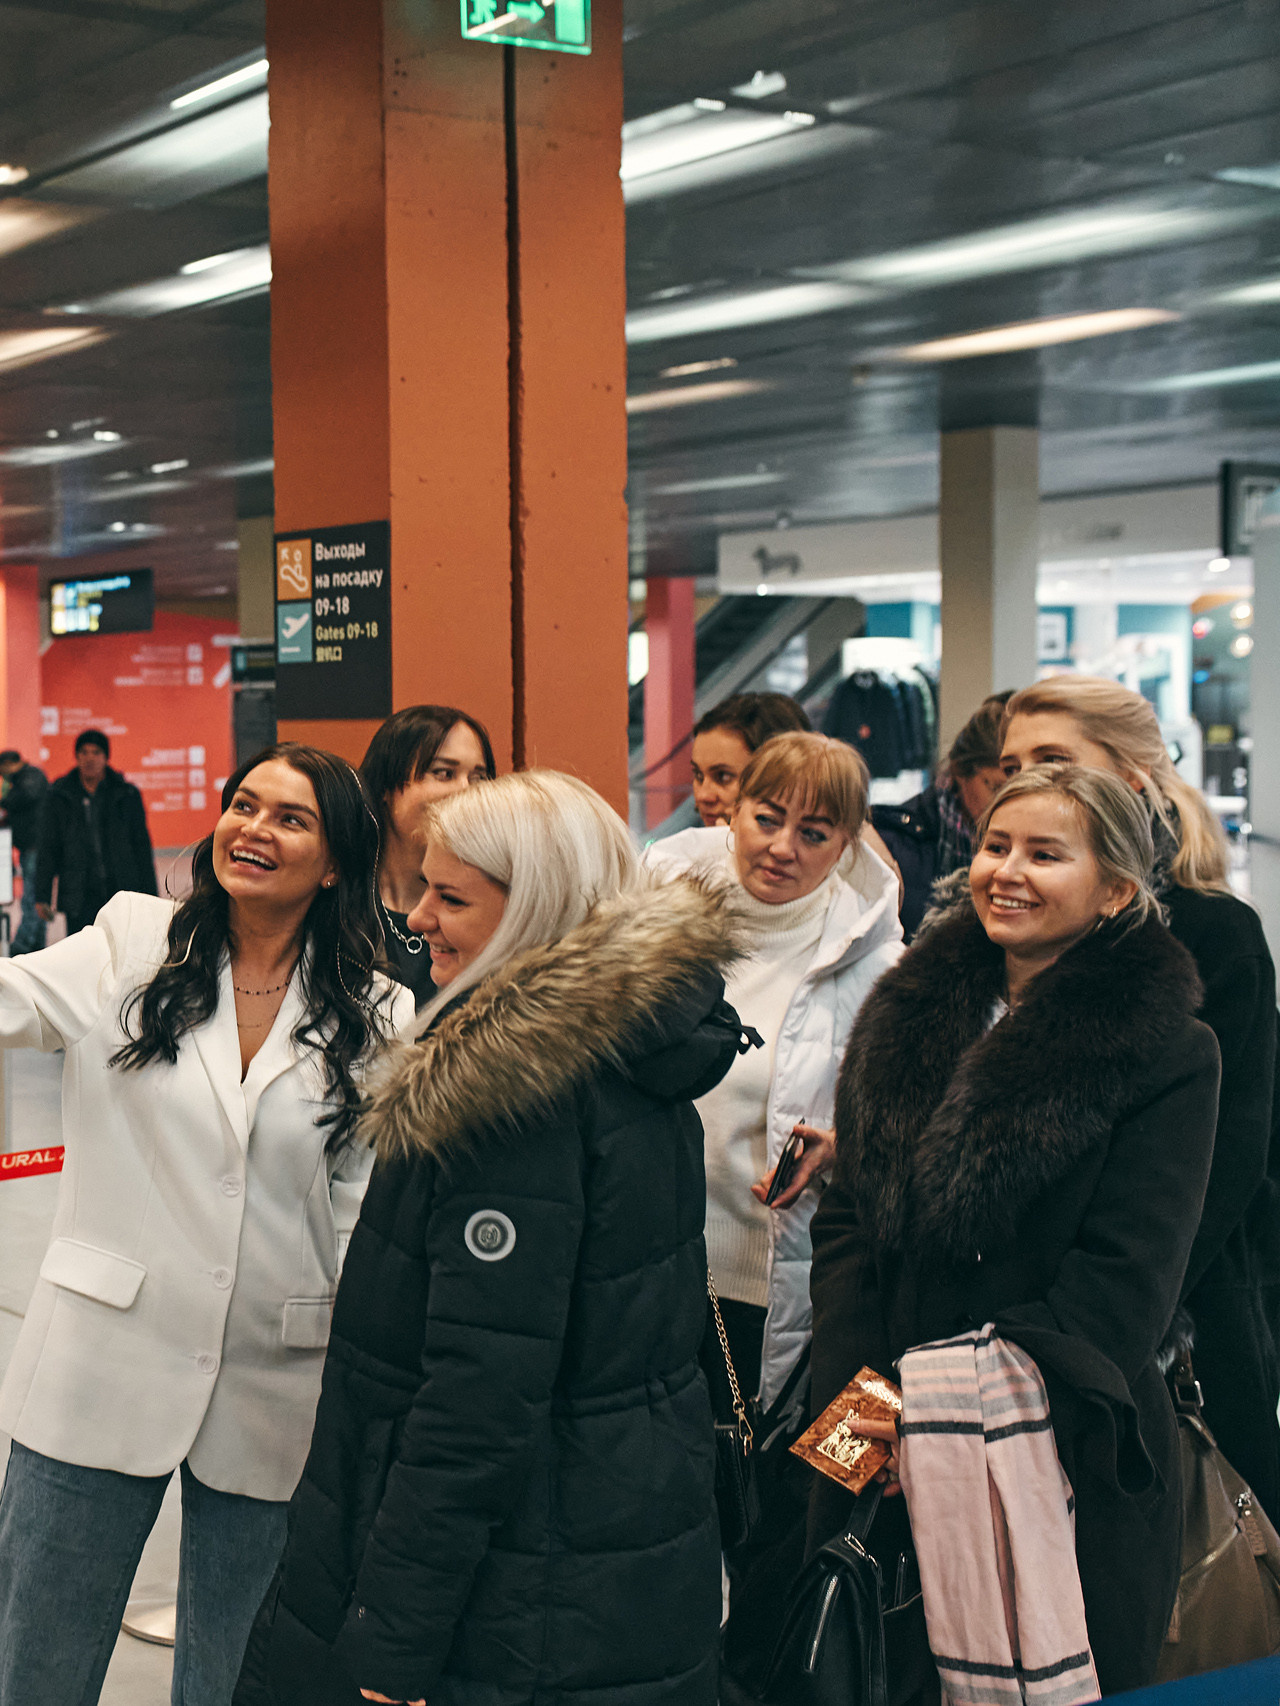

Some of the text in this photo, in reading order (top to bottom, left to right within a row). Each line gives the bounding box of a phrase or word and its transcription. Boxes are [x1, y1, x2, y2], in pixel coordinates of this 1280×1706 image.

[315, 542, 366, 561] Выходы
[315, 568, 383, 589] на посадку
[315, 595, 350, 616] 09-18
[316, 620, 378, 641] Gates 09-18
[2, 1150, 55, 1170] URAL
